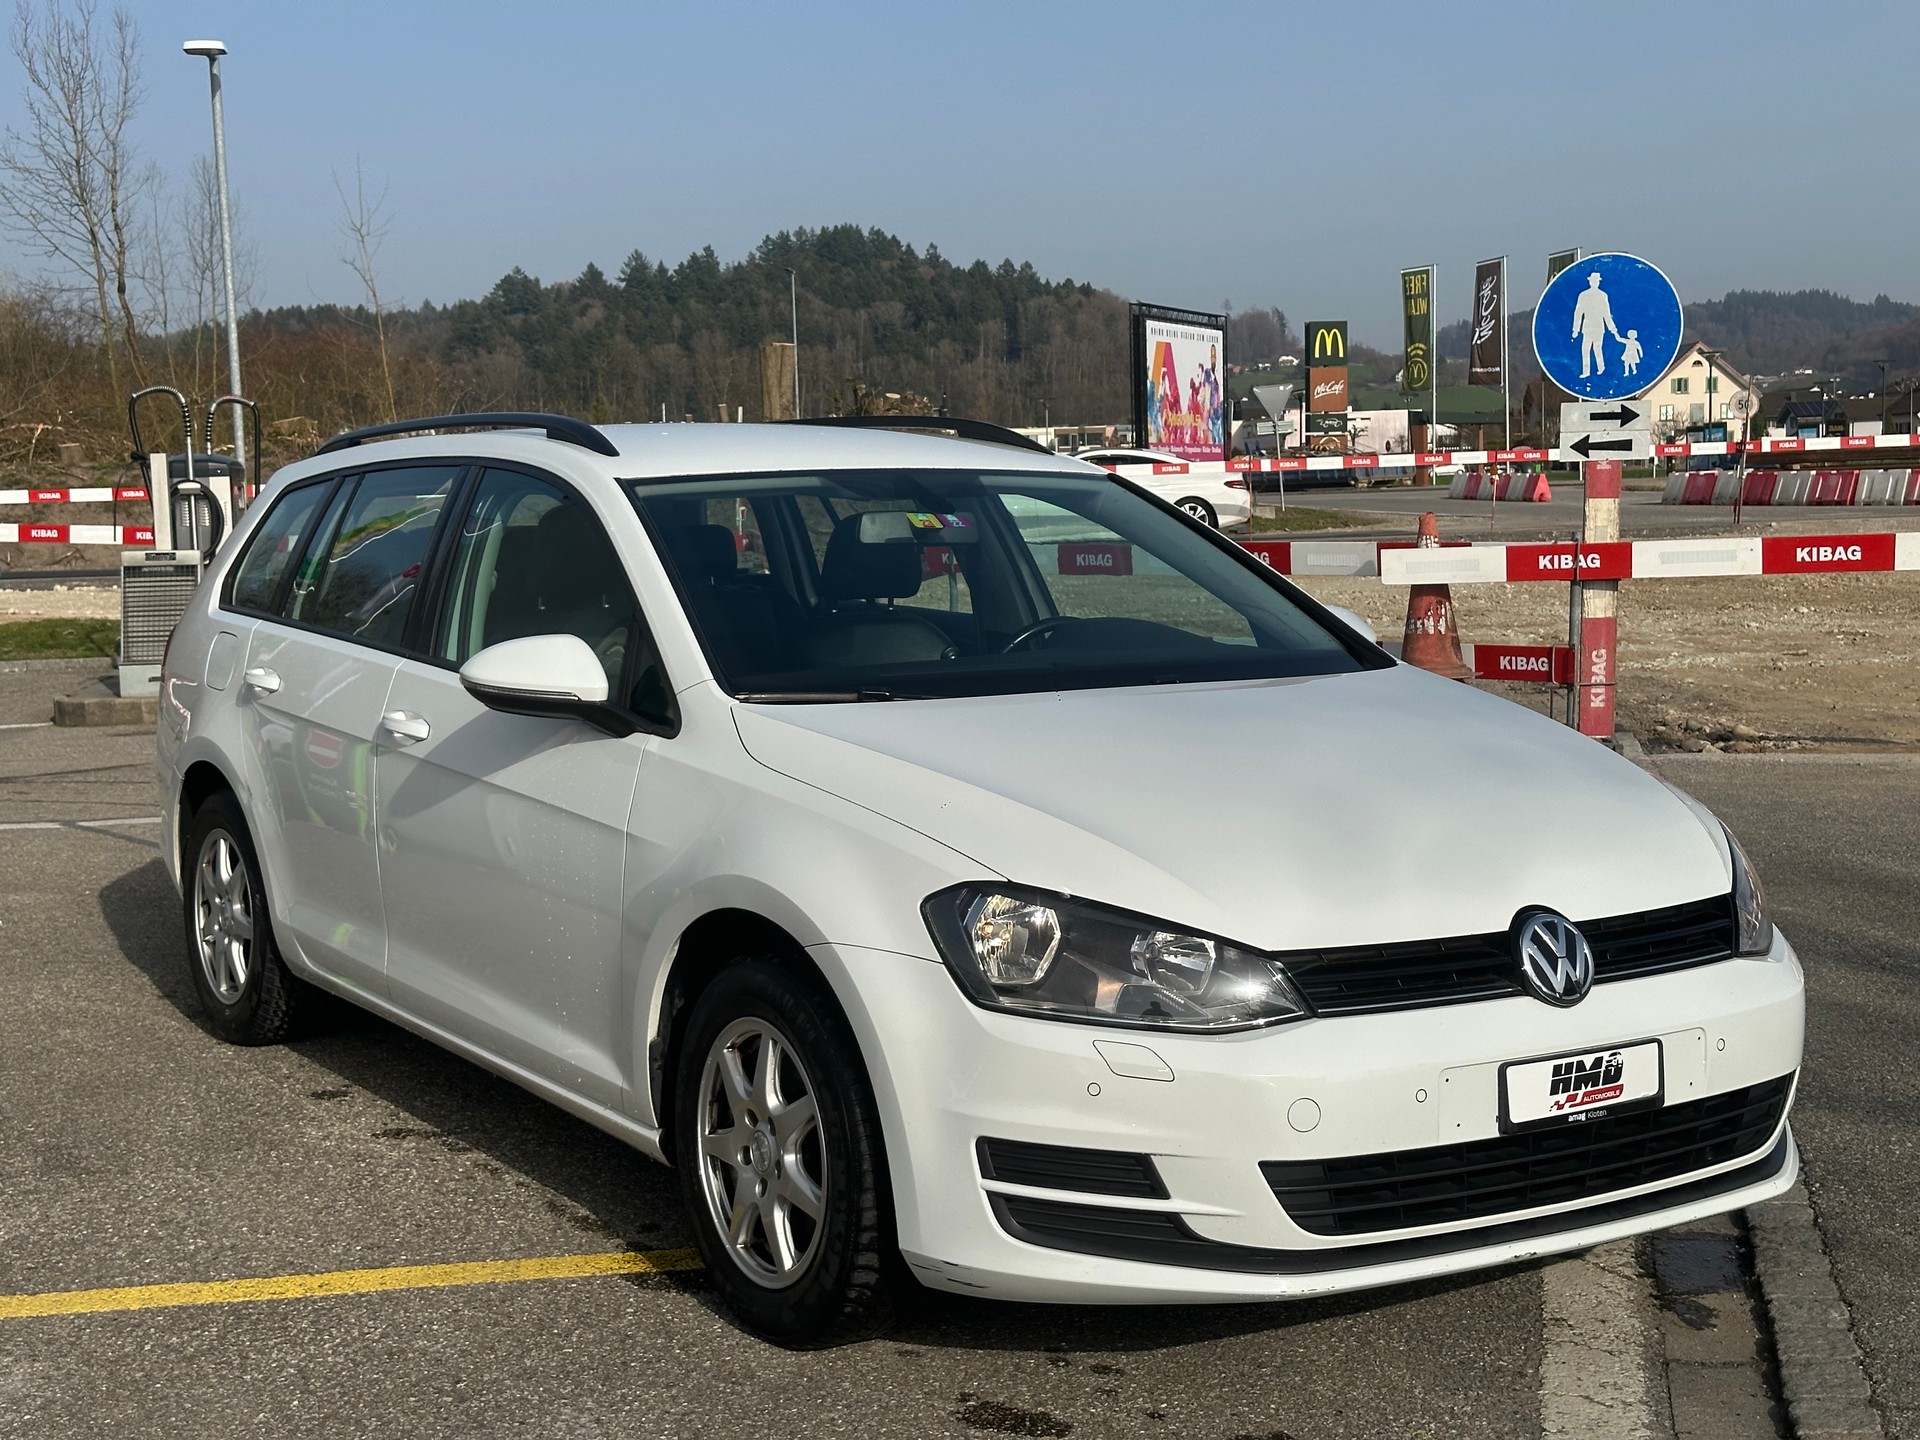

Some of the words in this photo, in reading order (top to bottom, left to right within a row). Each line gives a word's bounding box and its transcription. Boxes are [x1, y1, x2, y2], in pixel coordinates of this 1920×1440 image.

[1779, 441, 1797, 449] KIBAG
[1849, 438, 1867, 446] KIBAG
[38, 492, 60, 500] KIBAG
[122, 490, 144, 498] KIBAG
[31, 529, 58, 538] KIBAG
[136, 531, 154, 540] KIB
[1796, 544, 1862, 562] KIBAG
[1076, 554, 1112, 566] KIBAG
[1538, 554, 1600, 570] KIBAG
[1500, 656, 1549, 672] KIBAG
[1590, 648, 1607, 708] KIBAG
[1568, 1112, 1586, 1122] amag
[1587, 1108, 1607, 1119] Kloten
